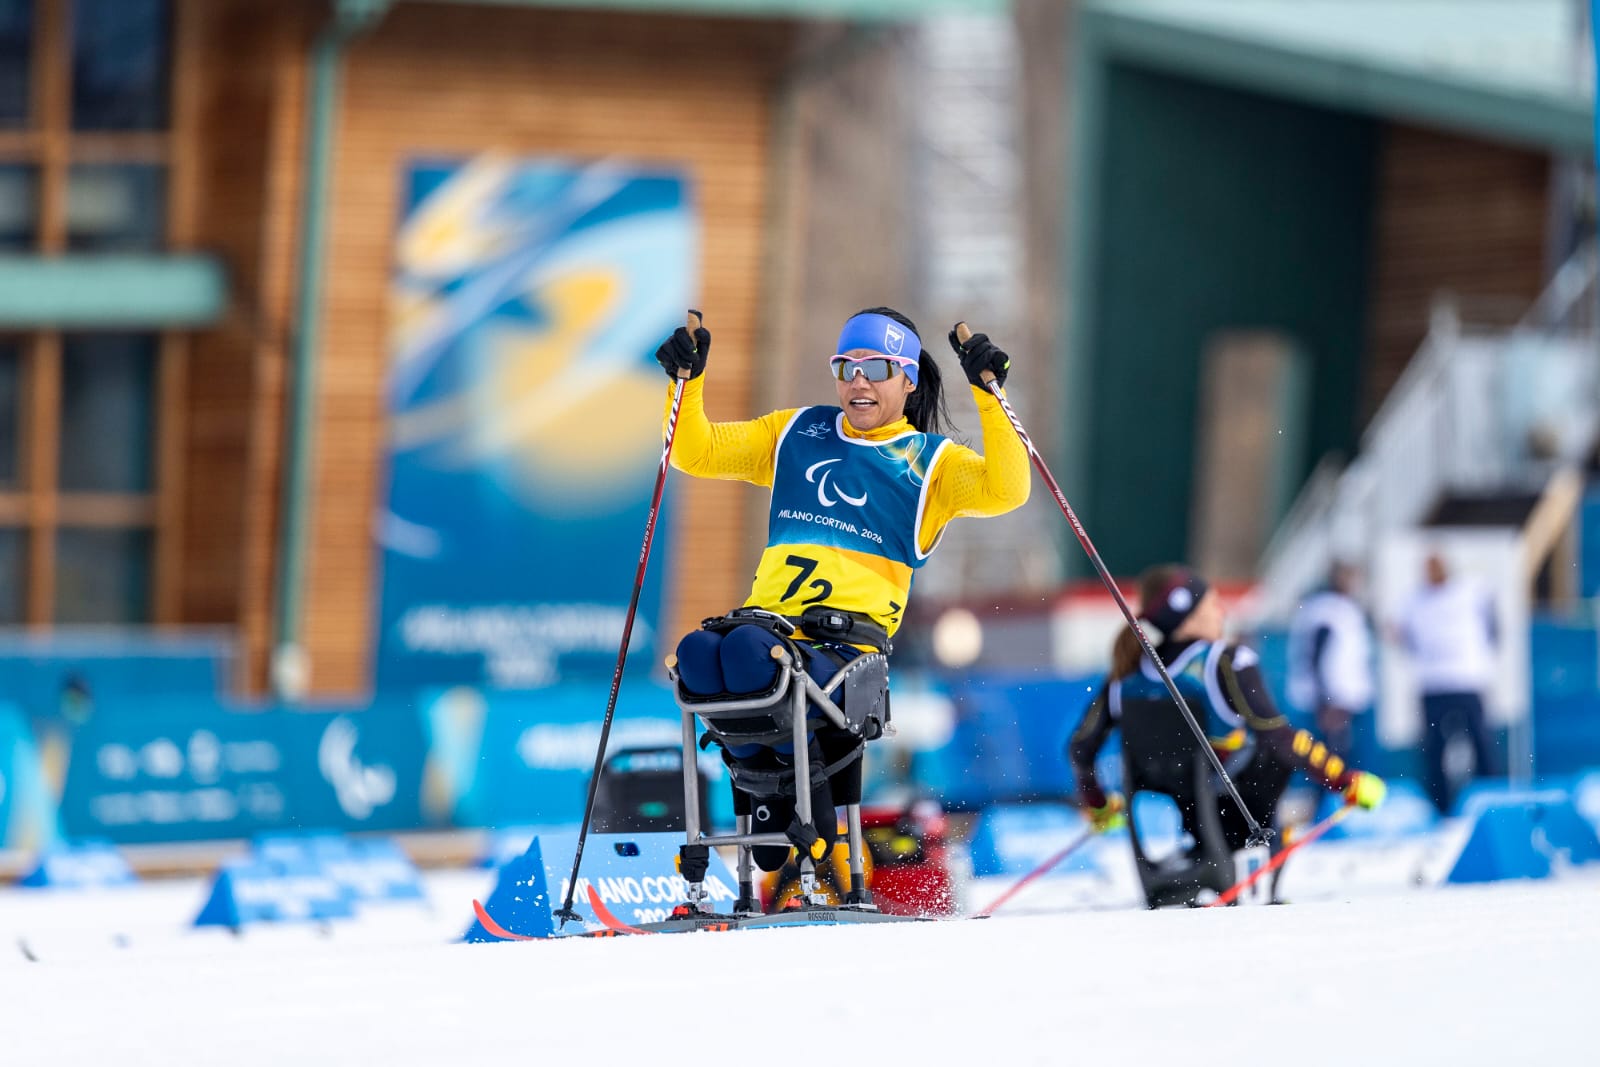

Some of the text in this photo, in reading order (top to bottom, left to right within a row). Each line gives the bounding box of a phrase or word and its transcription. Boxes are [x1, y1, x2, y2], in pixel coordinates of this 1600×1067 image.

[778, 509, 883, 544] MILANO CORTINA 2026
[642, 875, 739, 903] CORNA
